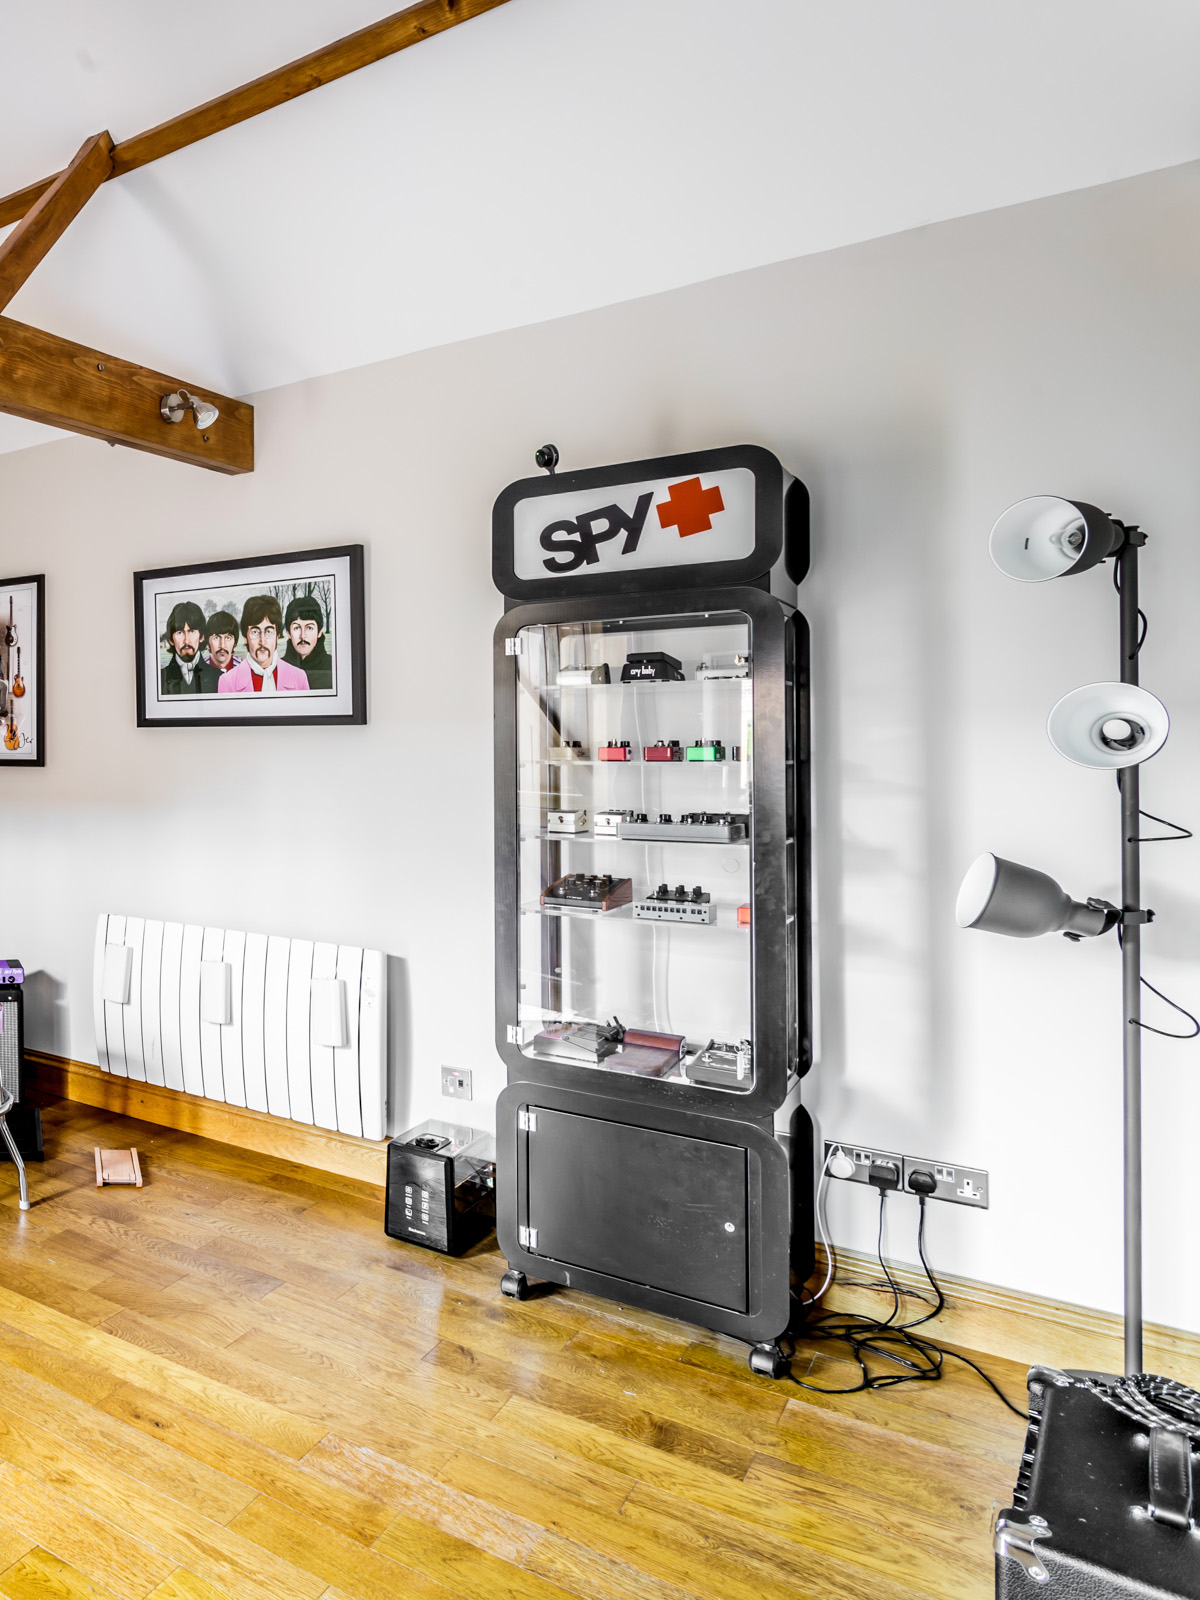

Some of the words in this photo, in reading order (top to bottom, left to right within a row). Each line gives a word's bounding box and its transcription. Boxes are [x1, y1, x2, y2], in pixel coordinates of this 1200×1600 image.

[539, 491, 654, 574] SPY
[630, 668, 641, 677] cry
[641, 665, 655, 677] baby
